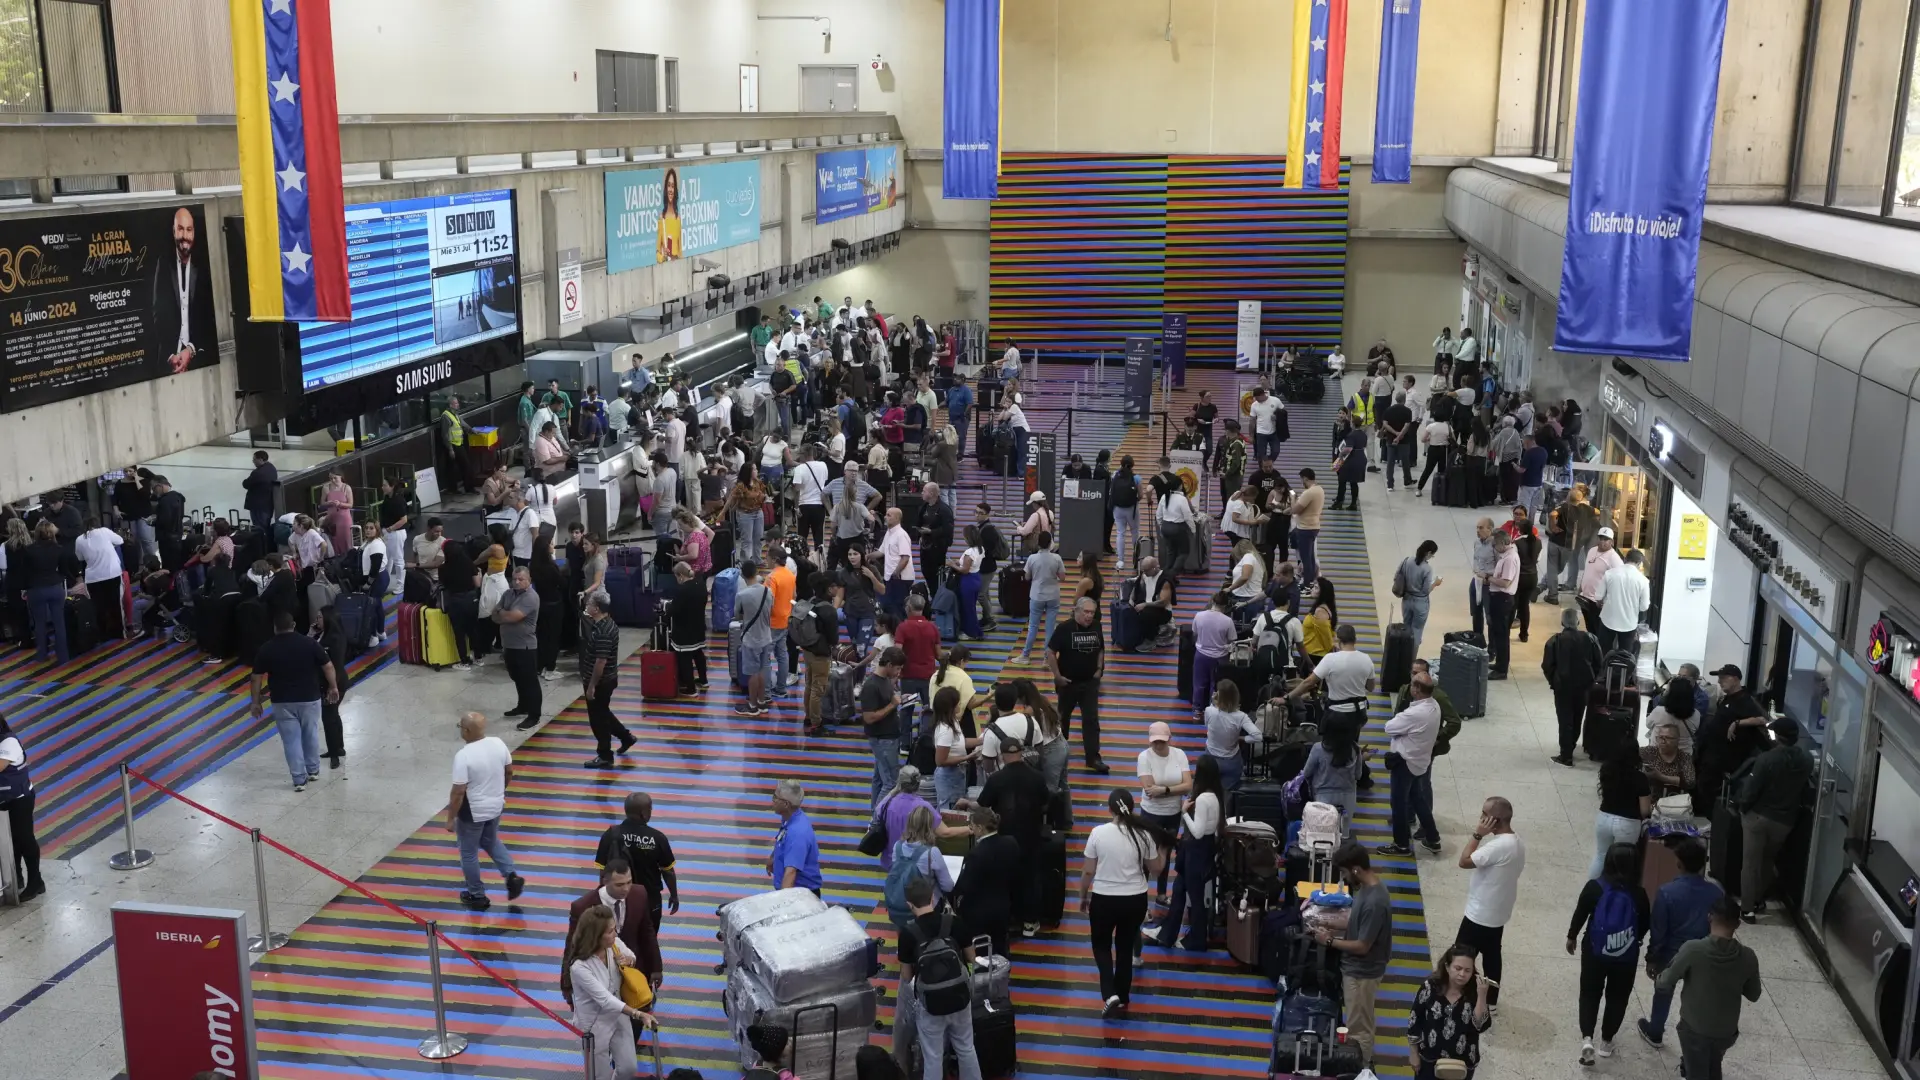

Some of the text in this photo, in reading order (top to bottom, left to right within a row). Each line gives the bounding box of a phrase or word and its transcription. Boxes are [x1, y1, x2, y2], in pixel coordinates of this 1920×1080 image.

[624, 182, 662, 210] VAMOS
[680, 177, 701, 202] A TU
[447, 211, 494, 234] SINIV
[617, 209, 659, 238] JUNTOS
[1590, 211, 1683, 240] ¡Disfruta tu viaje!
[48, 233, 65, 245] BDV
[88, 239, 133, 258] RUMBA
[91, 232, 102, 243] LA
[103, 229, 126, 240] GRAN
[441, 247, 453, 255] Mie
[453, 246, 461, 254] 31
[462, 243, 471, 252] Jul
[474, 234, 509, 255] 11:52
[681, 223, 719, 251] DESTINO
[0, 245, 41, 294] 30
[89, 287, 131, 303] Poliedro de
[96, 297, 127, 311] Caracas
[10, 311, 24, 327] 14
[23, 310, 48, 325] JUNIO
[48, 301, 77, 319] 2024
[396, 360, 452, 394] SAMSUNG
[1026, 436, 1039, 466] high
[1081, 490, 1102, 500] high
[156, 931, 203, 943] IBERIA
[1606, 925, 1634, 950] NIKE
